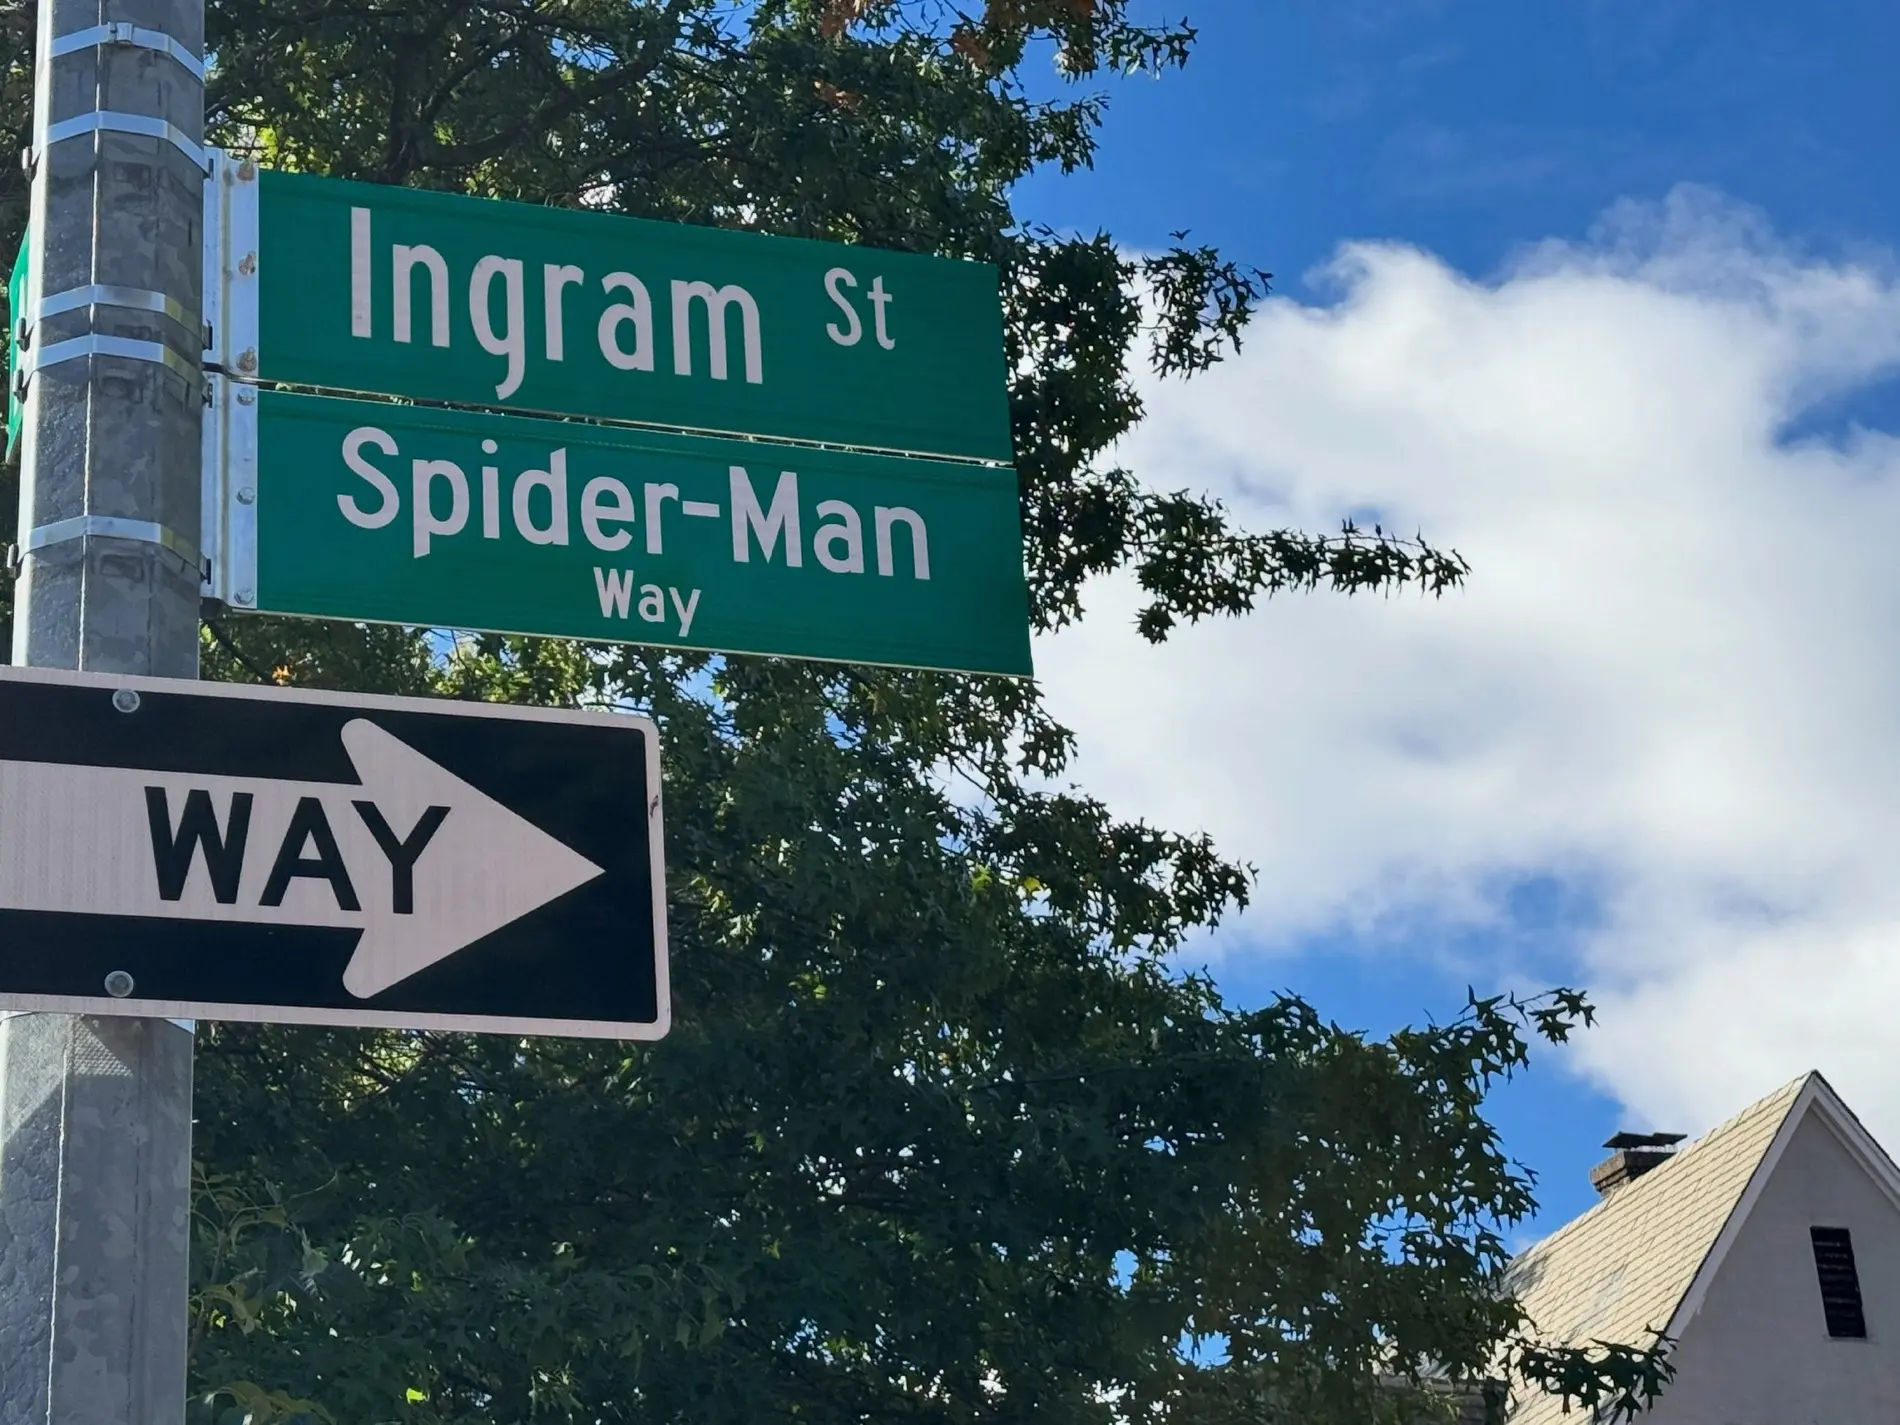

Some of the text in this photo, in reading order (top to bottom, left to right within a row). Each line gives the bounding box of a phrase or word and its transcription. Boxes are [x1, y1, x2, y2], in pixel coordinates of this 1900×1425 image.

[349, 206, 896, 400] Ingram St
[336, 426, 931, 581] Spider-Man
[592, 566, 702, 638] Way
[144, 786, 451, 915] WAY
